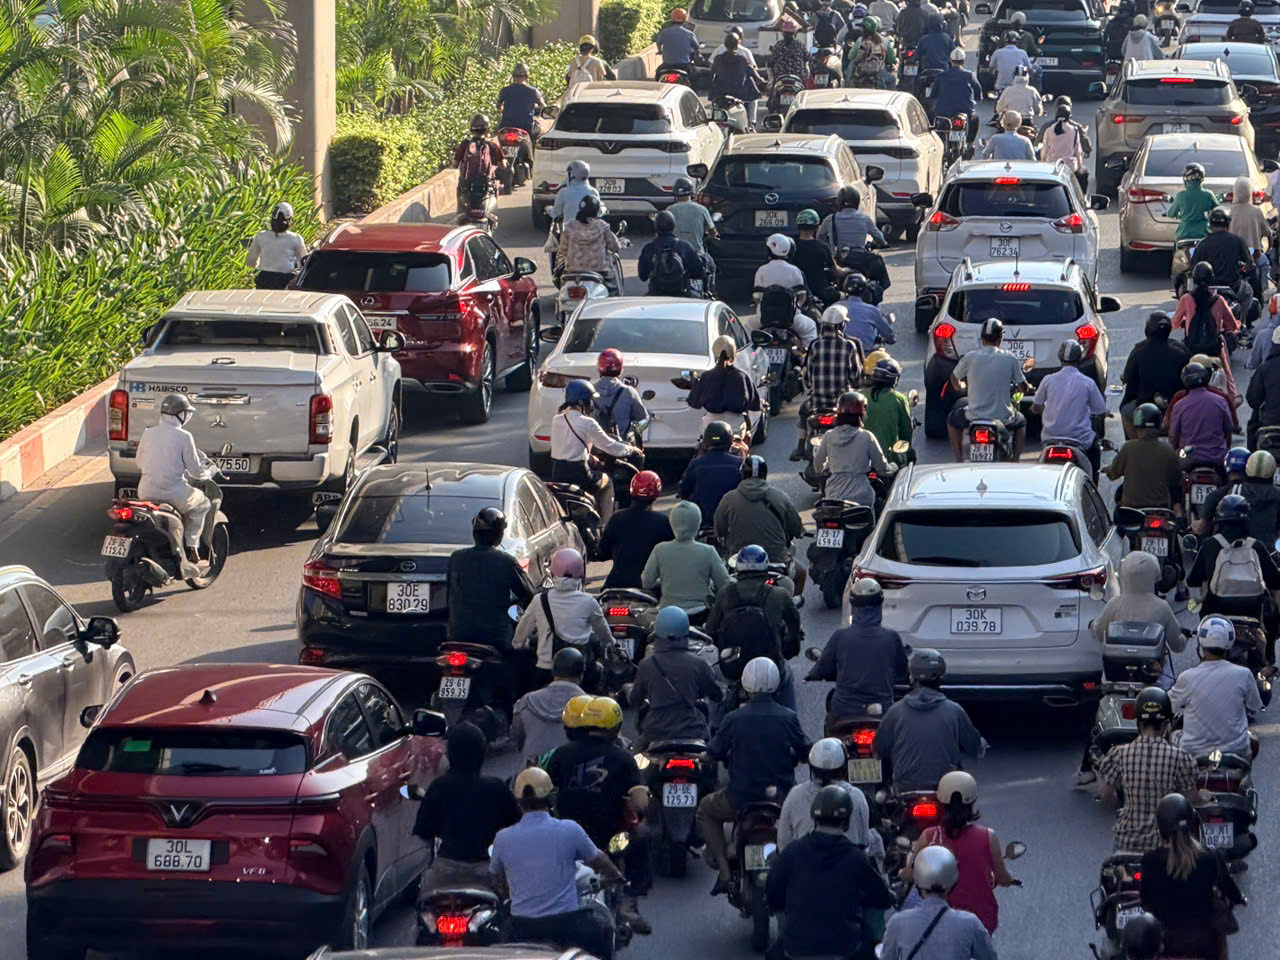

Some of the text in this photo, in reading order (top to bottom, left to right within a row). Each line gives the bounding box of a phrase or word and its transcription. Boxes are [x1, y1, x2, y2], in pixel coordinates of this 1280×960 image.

[149, 385, 188, 393] HABISCO
[397, 584, 420, 597] 30E
[388, 599, 428, 610] 830.29
[966, 609, 986, 620] 30K
[956, 621, 996, 631] 039.78
[166, 841, 192, 853] 30L
[154, 855, 202, 868] 688.70
